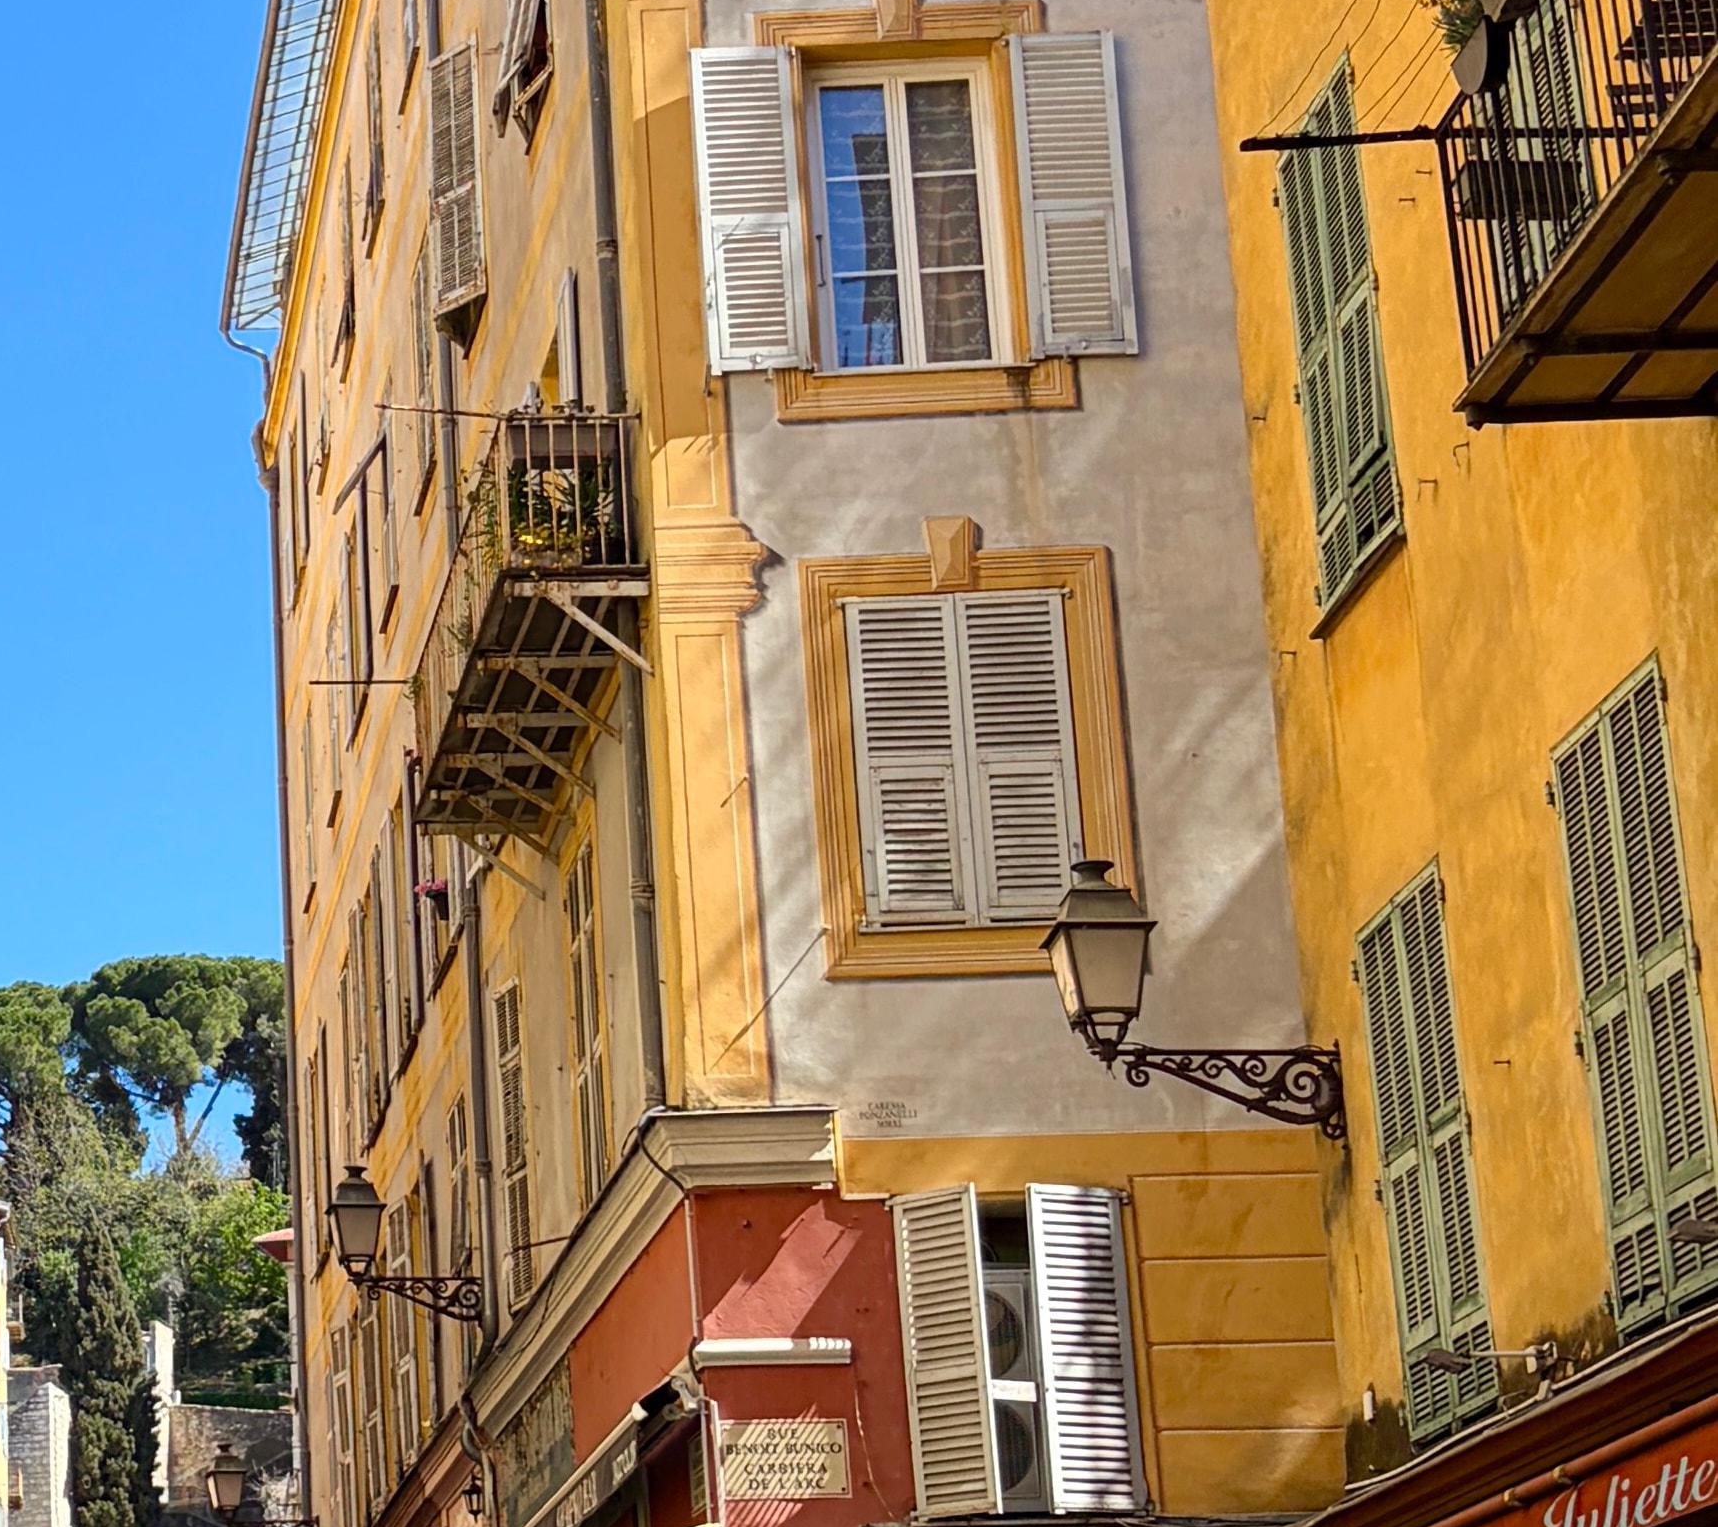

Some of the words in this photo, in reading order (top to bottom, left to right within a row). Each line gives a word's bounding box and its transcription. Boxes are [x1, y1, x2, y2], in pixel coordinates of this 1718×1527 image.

[767, 1427, 798, 1440] RUE
[785, 1442, 842, 1454] BUNICO
[748, 1478, 770, 1491] DE
